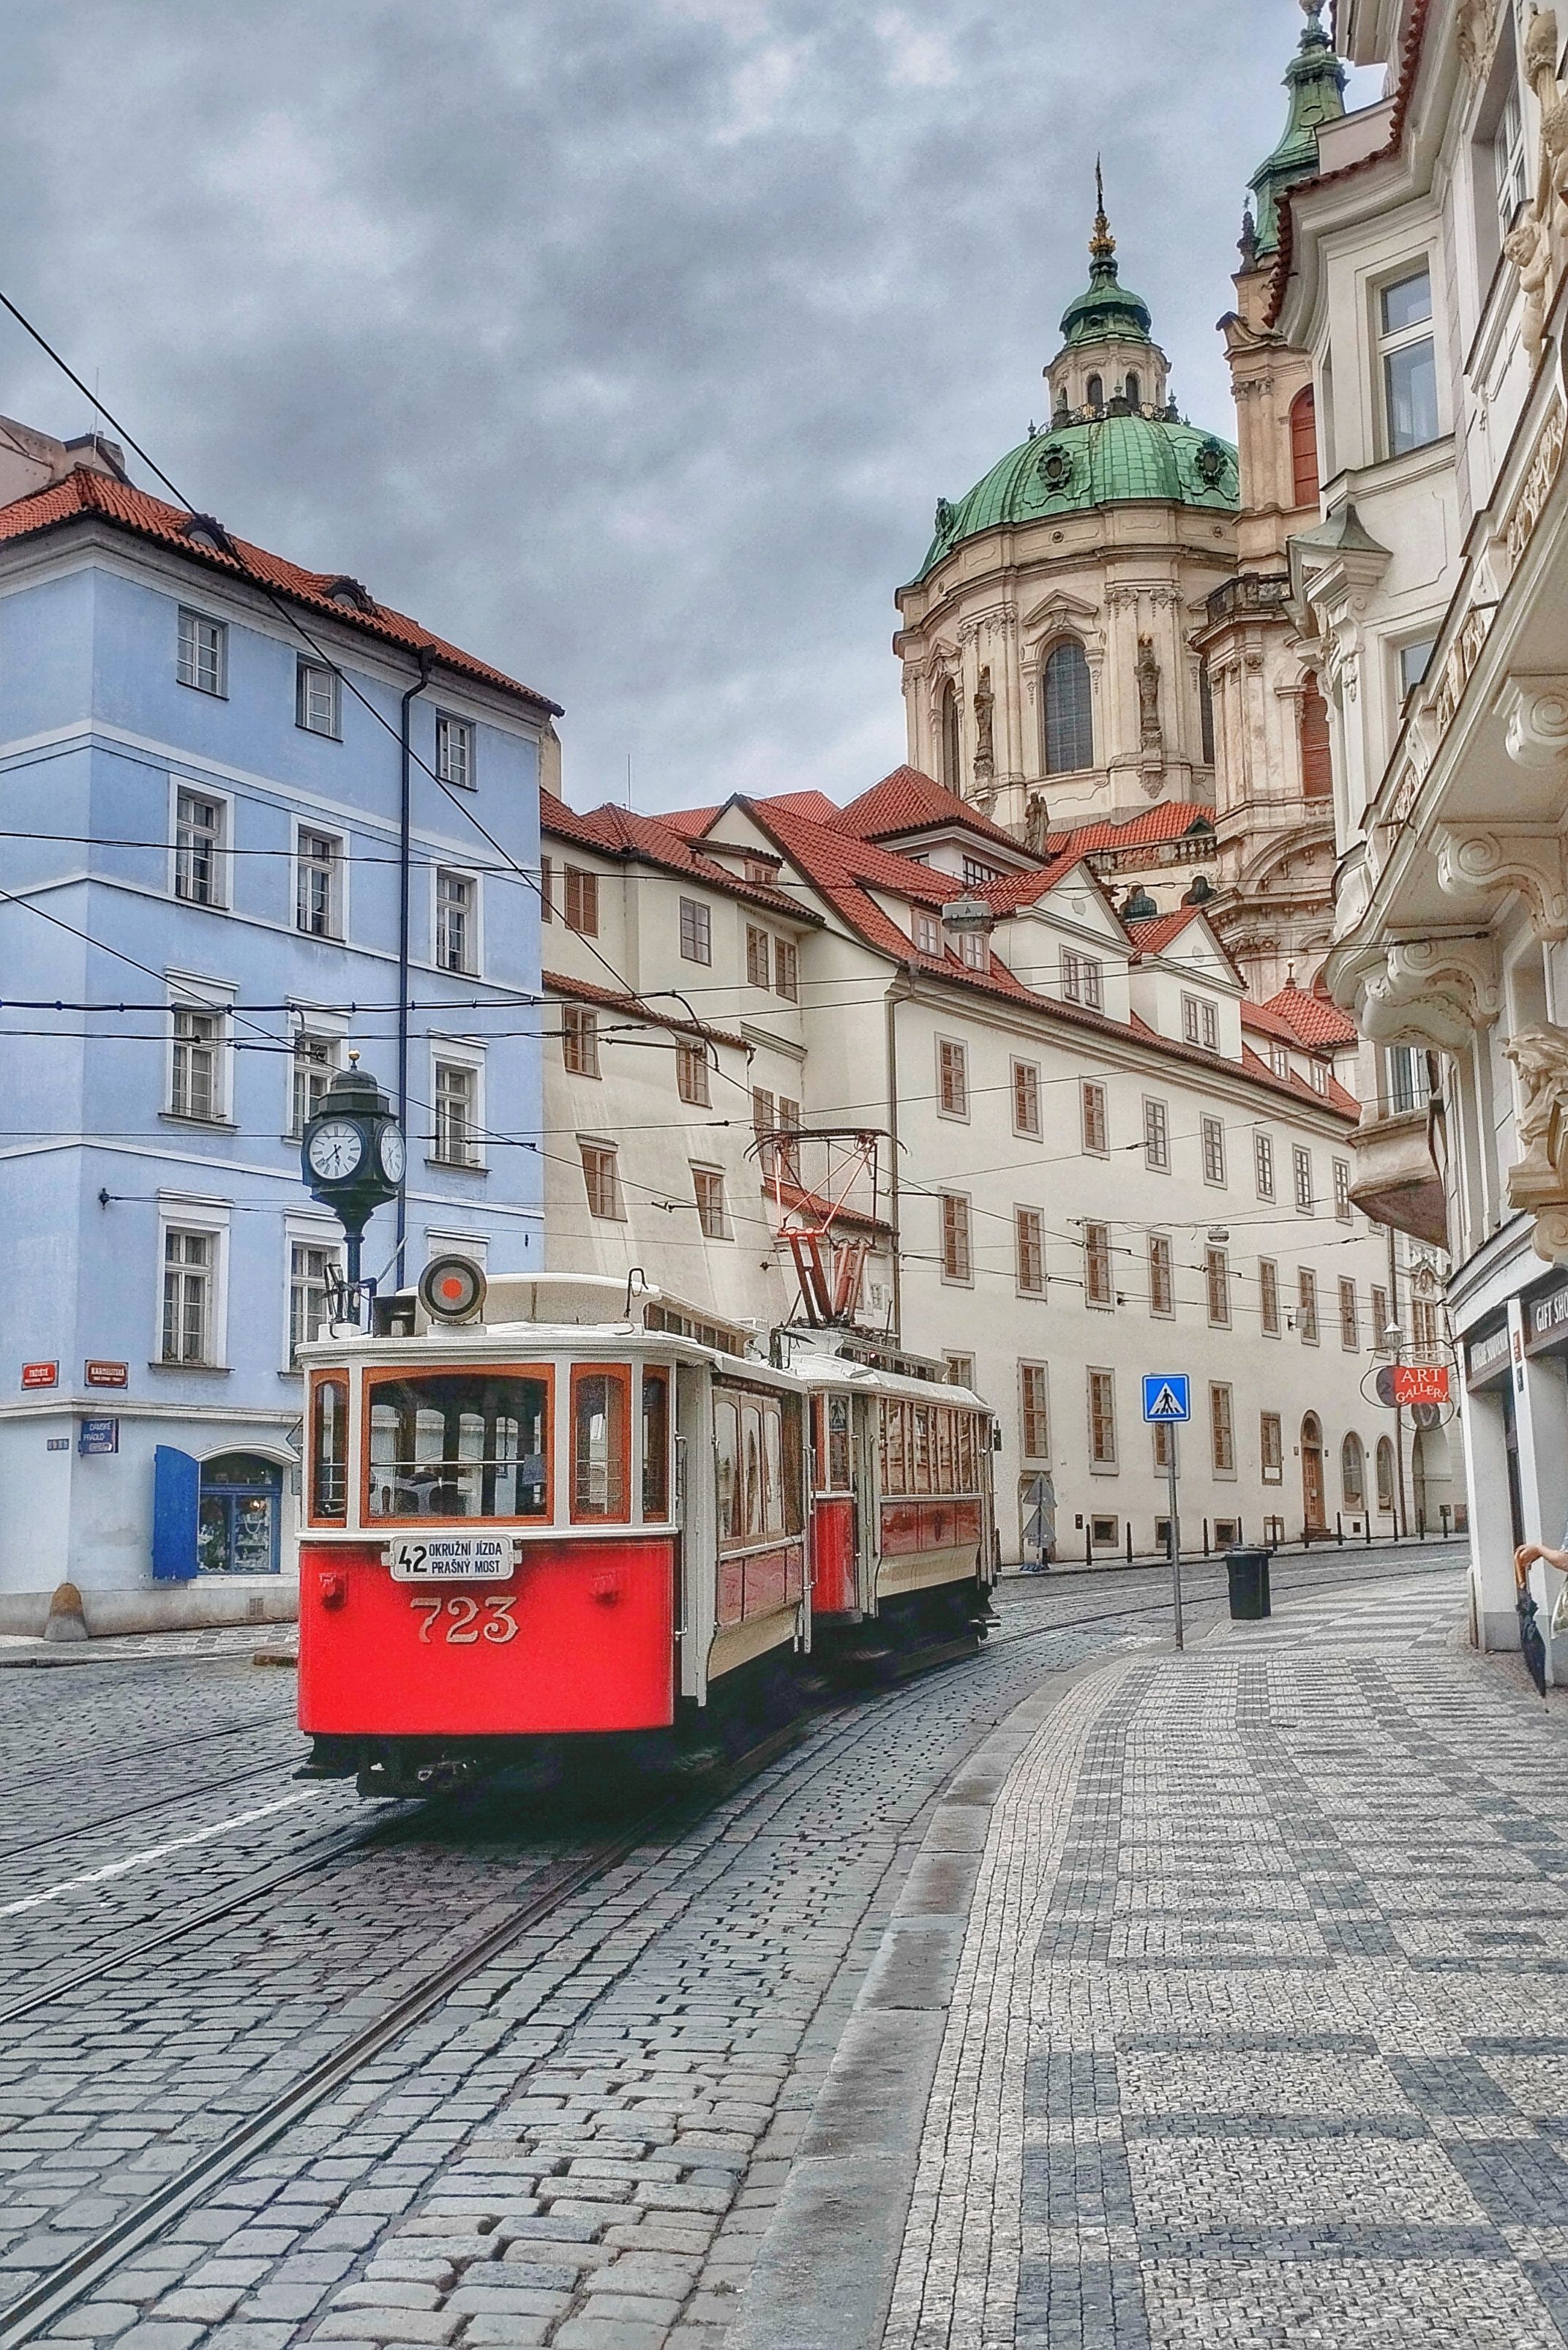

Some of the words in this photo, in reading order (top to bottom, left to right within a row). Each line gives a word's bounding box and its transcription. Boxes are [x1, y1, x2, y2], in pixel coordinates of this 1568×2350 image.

[1537, 1301, 1552, 1332] GIFT
[1401, 1368, 1441, 1382] ART
[1395, 1382, 1449, 1403] GALLERY
[429, 1541, 471, 1557] OKRUŽNÍ
[475, 1540, 502, 1556] JÍZDA
[399, 1546, 427, 1573] 42
[432, 1558, 470, 1574] PRAŠNÝ
[474, 1560, 500, 1573] MOST
[410, 1596, 519, 1643] 723
